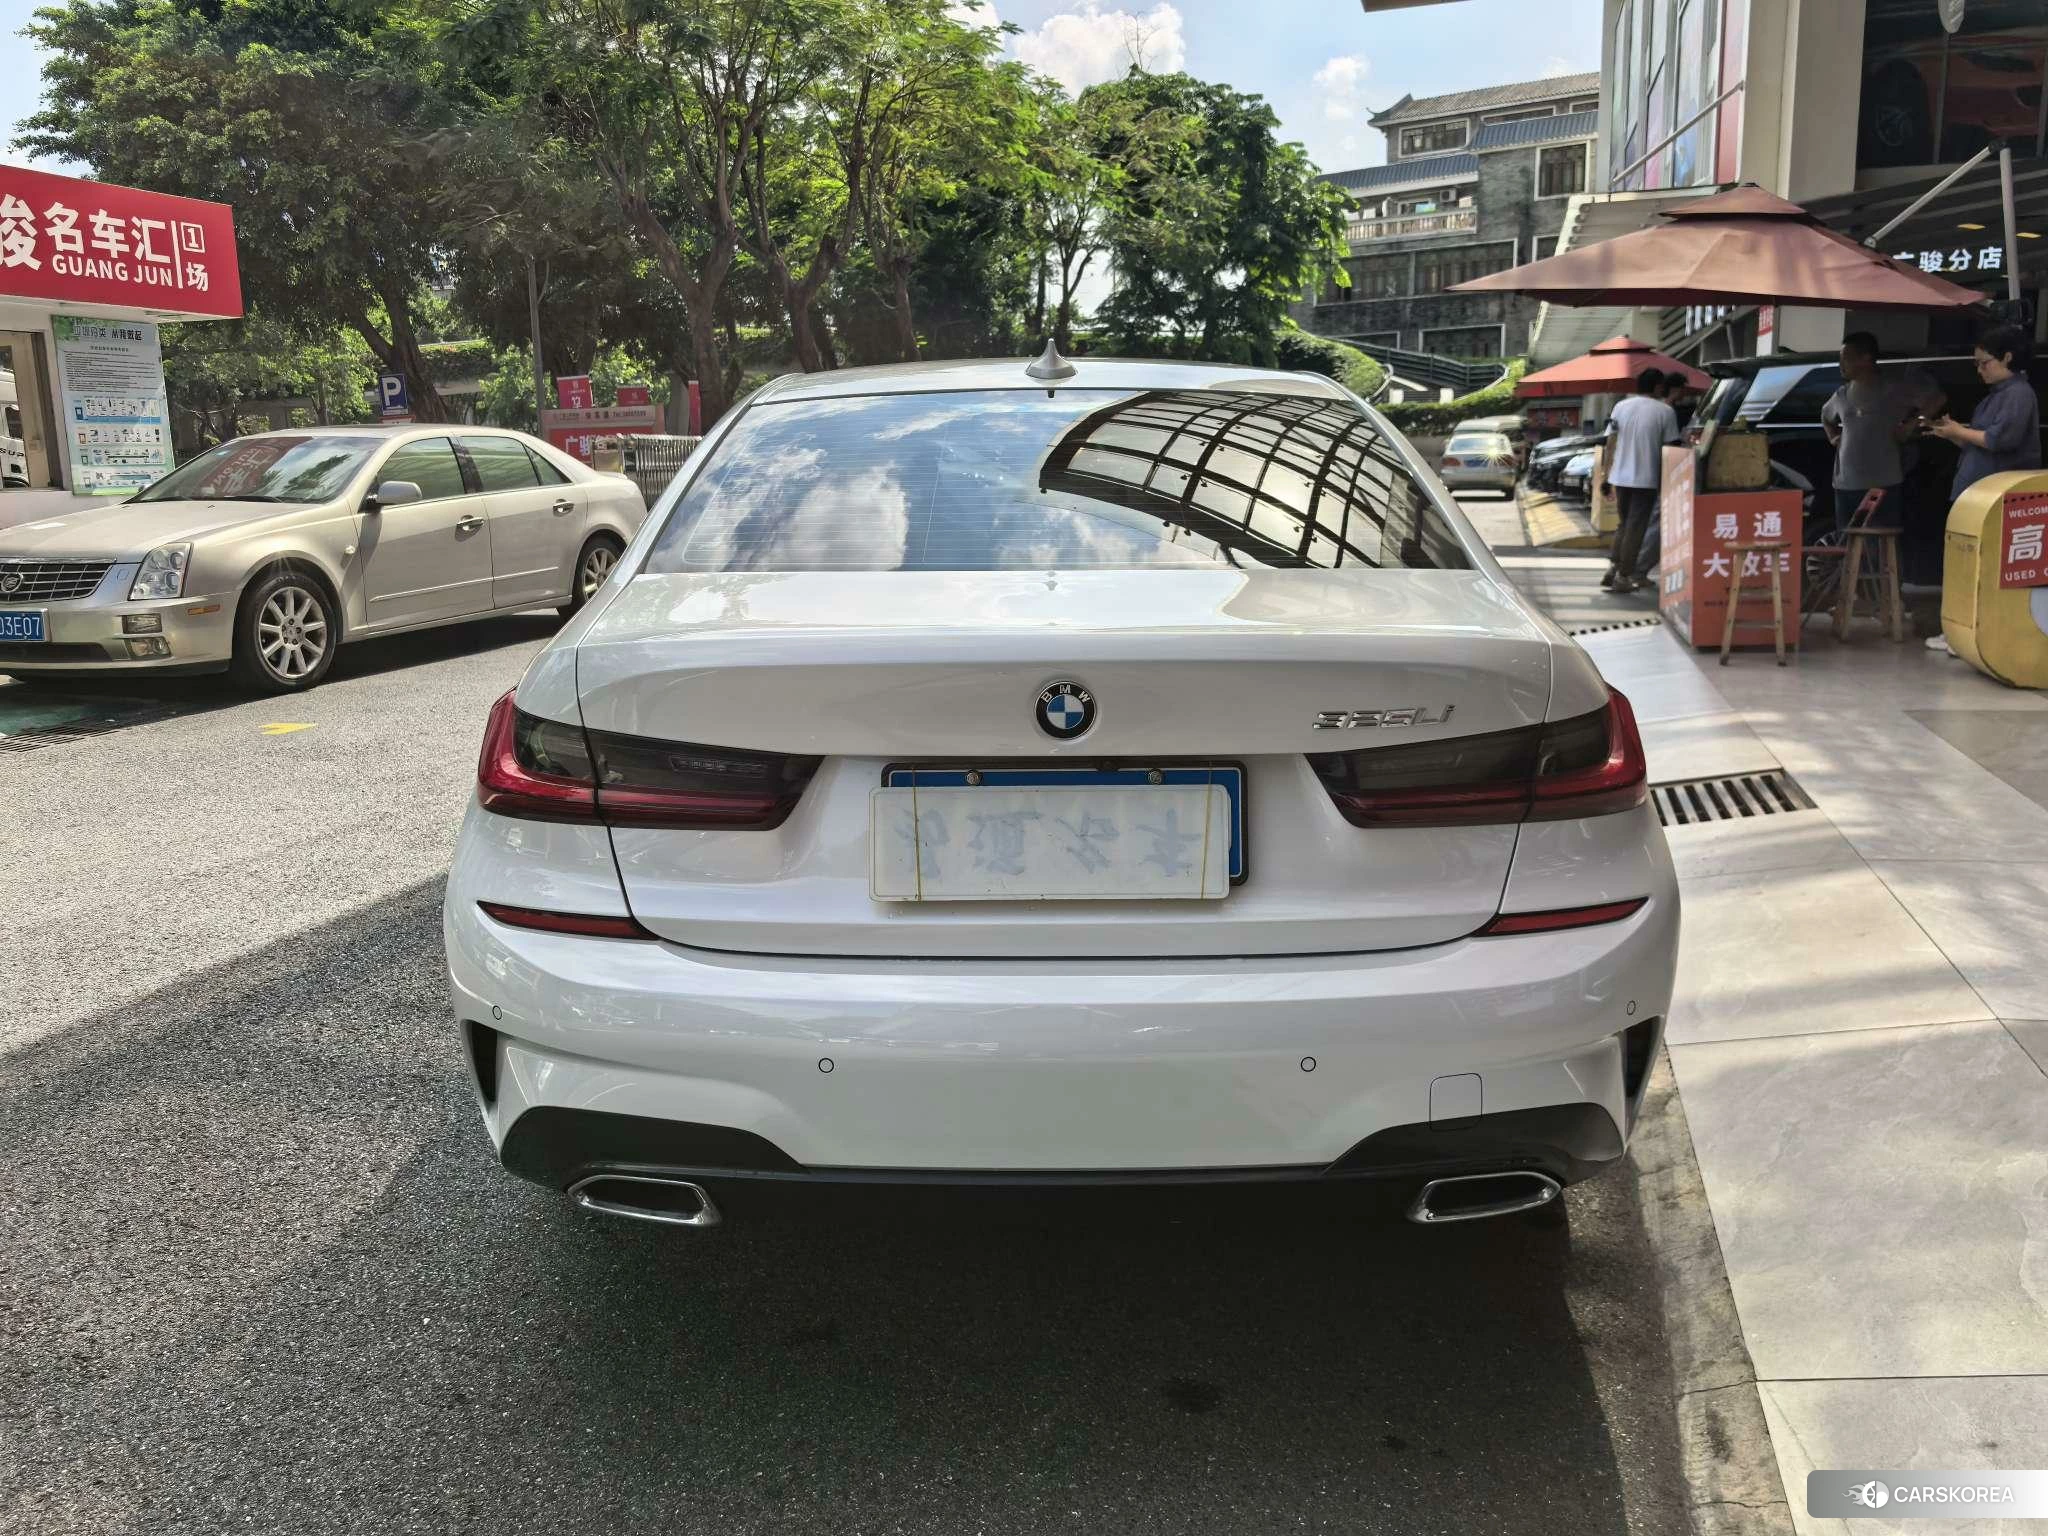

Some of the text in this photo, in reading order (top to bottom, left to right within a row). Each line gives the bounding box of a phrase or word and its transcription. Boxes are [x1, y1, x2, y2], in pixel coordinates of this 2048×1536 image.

[52, 254, 173, 287] GUANG JUN
[186, 261, 209, 291] 场
[382, 376, 402, 406] P
[1713, 511, 1782, 538] 易通
[2008, 524, 2046, 564] 高
[2004, 569, 2037, 582] USED
[1041, 684, 1091, 703] BMW
